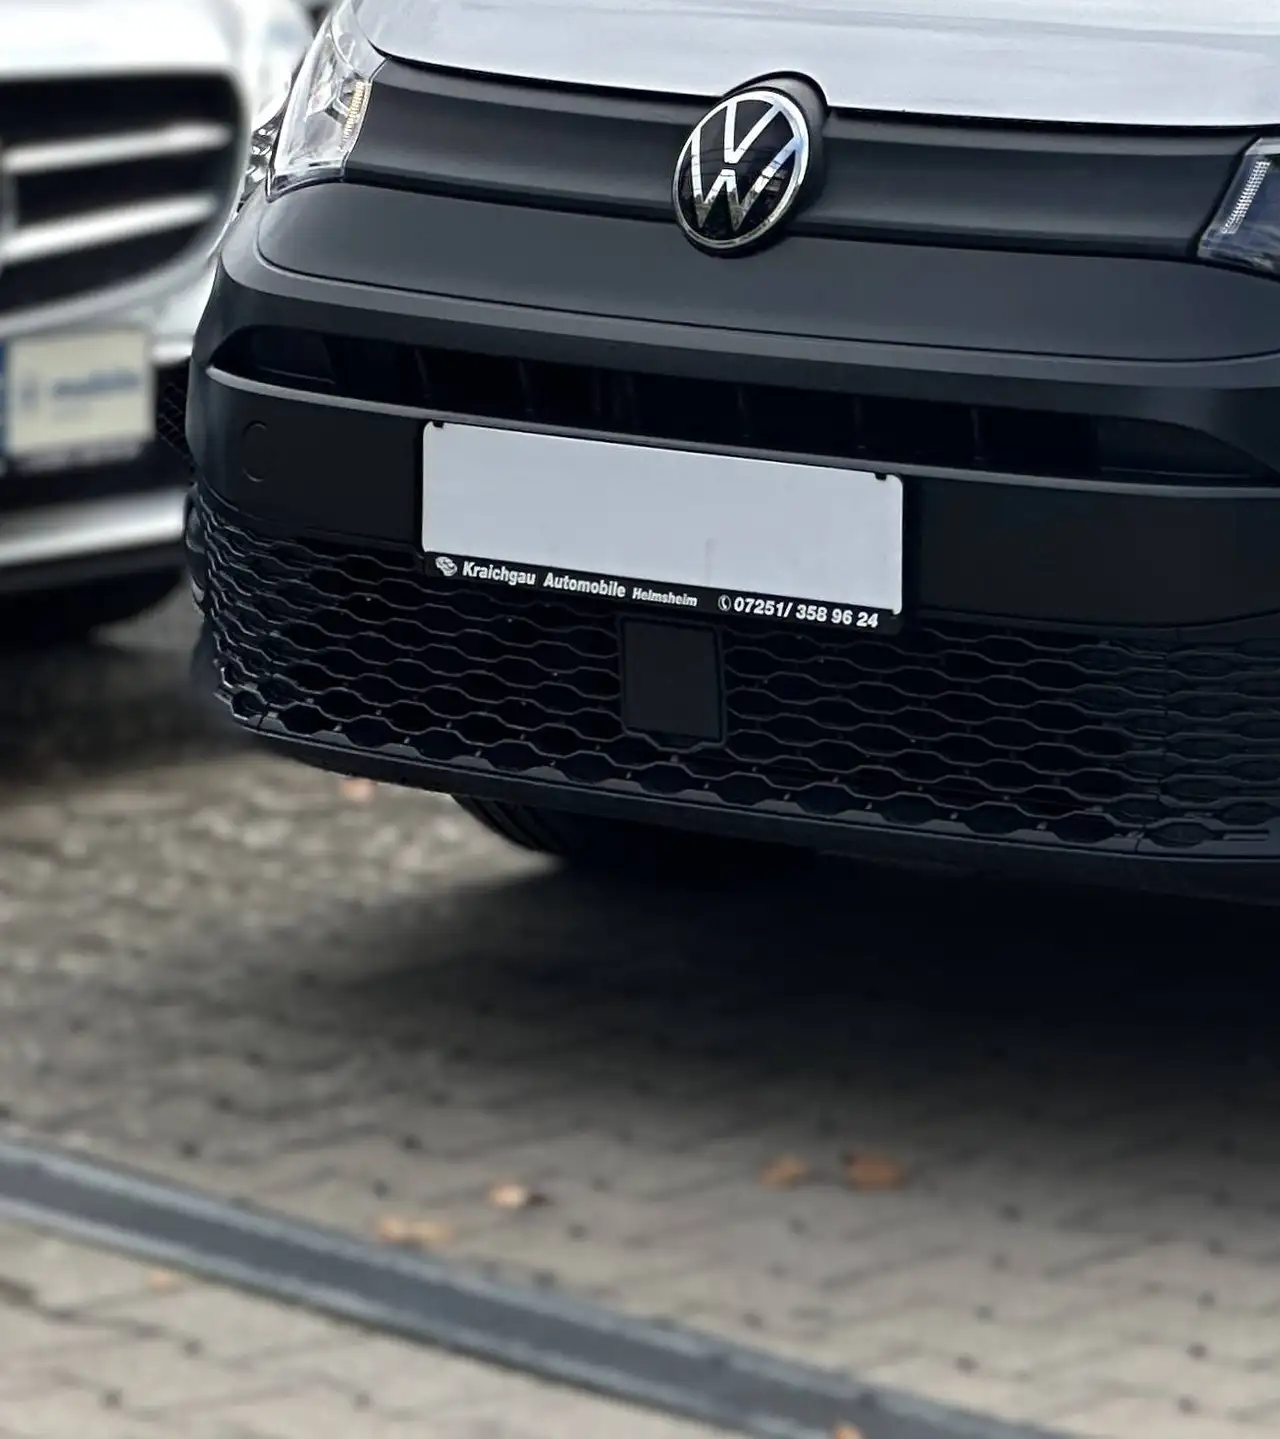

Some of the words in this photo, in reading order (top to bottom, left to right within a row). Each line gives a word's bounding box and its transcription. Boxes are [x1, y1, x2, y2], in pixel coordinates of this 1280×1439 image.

[684, 95, 805, 238] VW
[462, 561, 536, 586] Kraichgau
[543, 572, 626, 598] Automobile
[632, 587, 698, 607] Helmsheim
[734, 597, 792, 619] 07251/
[796, 604, 827, 623] 358
[831, 608, 852, 625] 96
[856, 611, 879, 629] 24
